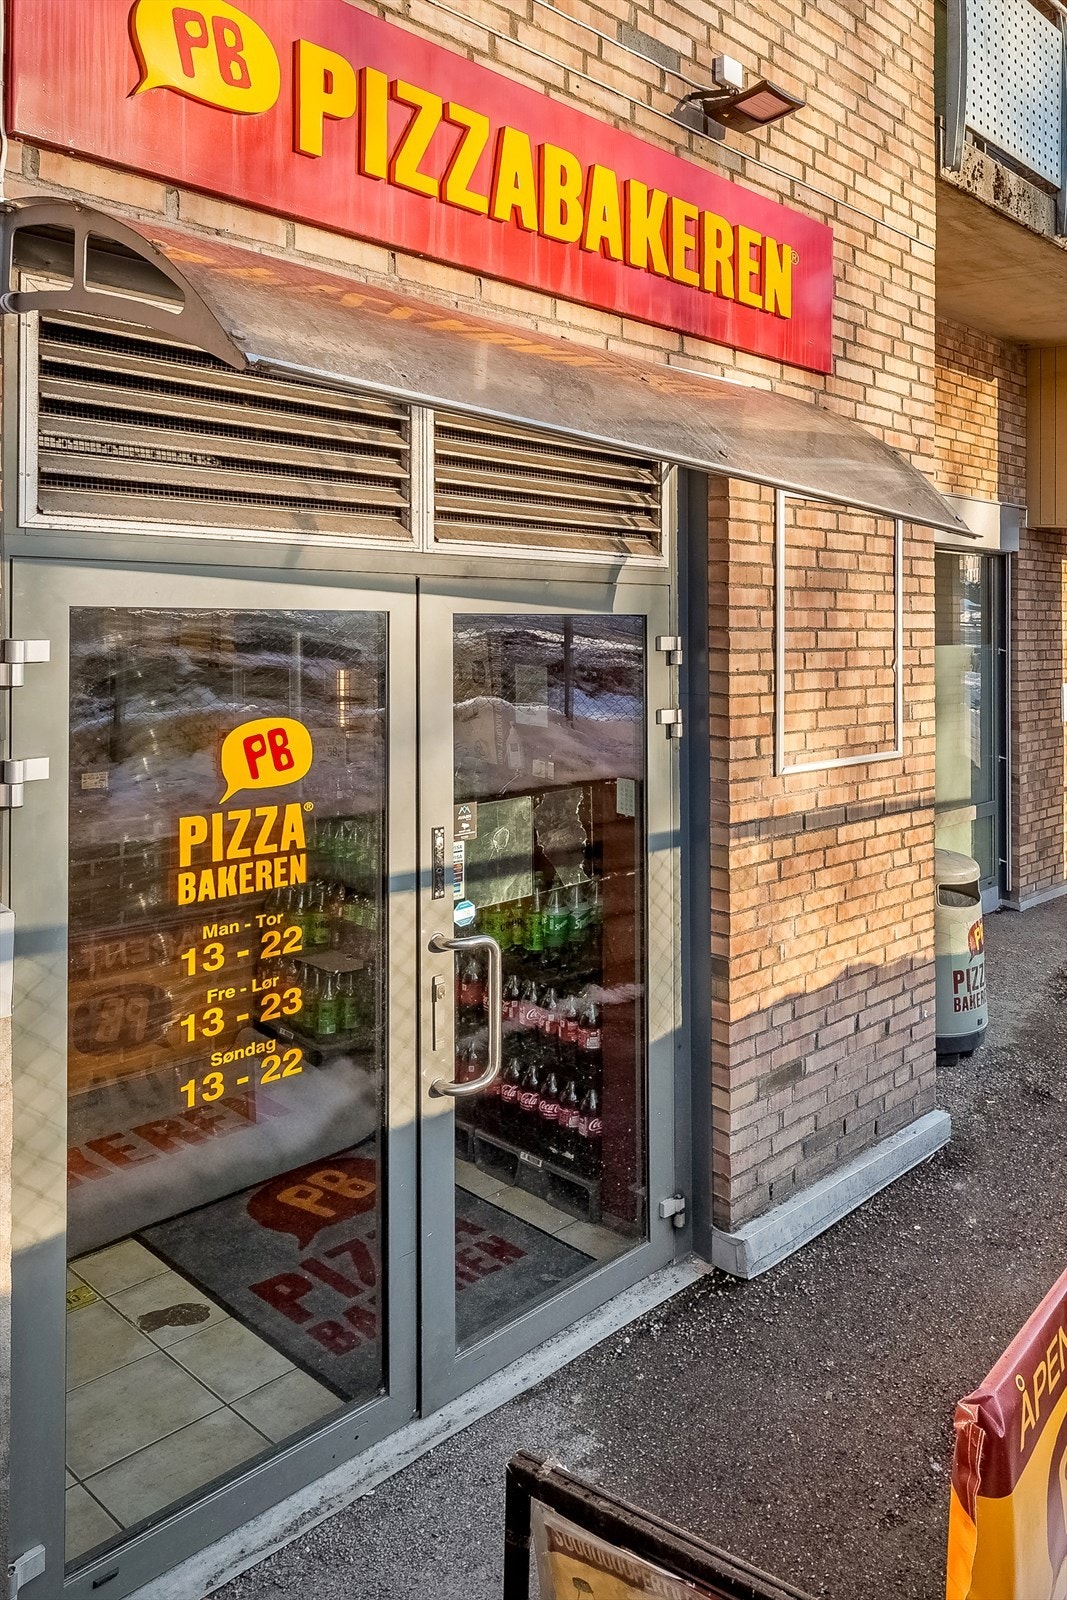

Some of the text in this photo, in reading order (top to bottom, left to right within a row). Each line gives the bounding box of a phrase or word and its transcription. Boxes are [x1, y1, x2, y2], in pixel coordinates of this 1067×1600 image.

[172, 7, 252, 89] PB
[243, 727, 295, 780] PB
[178, 853, 307, 906] BAKEREN
[181, 942, 225, 977] 13
[260, 925, 303, 959] 22
[202, 921, 240, 940] Man
[255, 912, 284, 928] Tor
[180, 1007, 225, 1043] 13
[259, 987, 303, 1023] 23
[206, 986, 236, 1004] Fre
[252, 975, 280, 993] Lør
[180, 1071, 225, 1109] 13
[260, 1048, 303, 1085] 22
[210, 1038, 277, 1067] Søndag
[276, 1169, 377, 1218] PB
